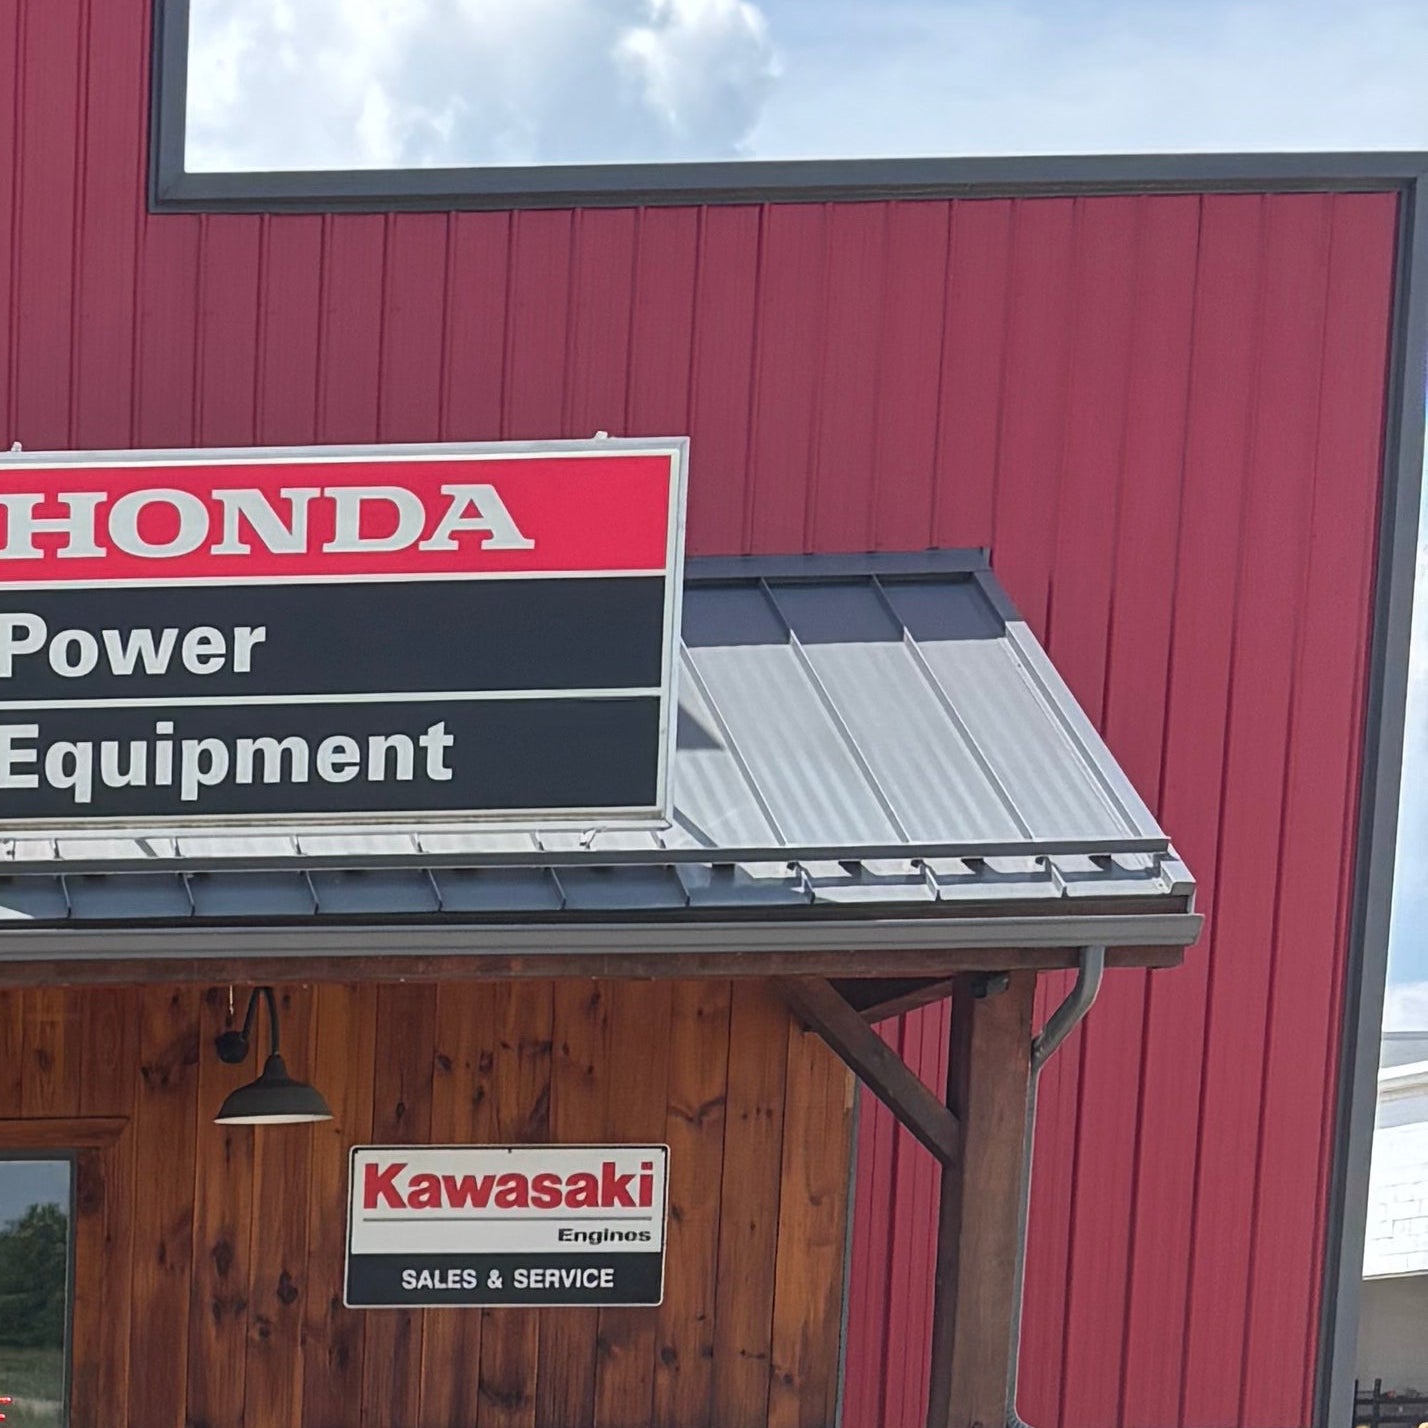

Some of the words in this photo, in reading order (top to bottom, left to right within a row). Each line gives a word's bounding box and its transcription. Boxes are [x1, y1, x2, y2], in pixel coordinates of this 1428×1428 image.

[362, 1160, 654, 1210] Kawasaki
[557, 1226, 652, 1246] Engines
[401, 1268, 478, 1290] SALES
[486, 1269, 503, 1289] &
[513, 1267, 615, 1289] SERVICE
